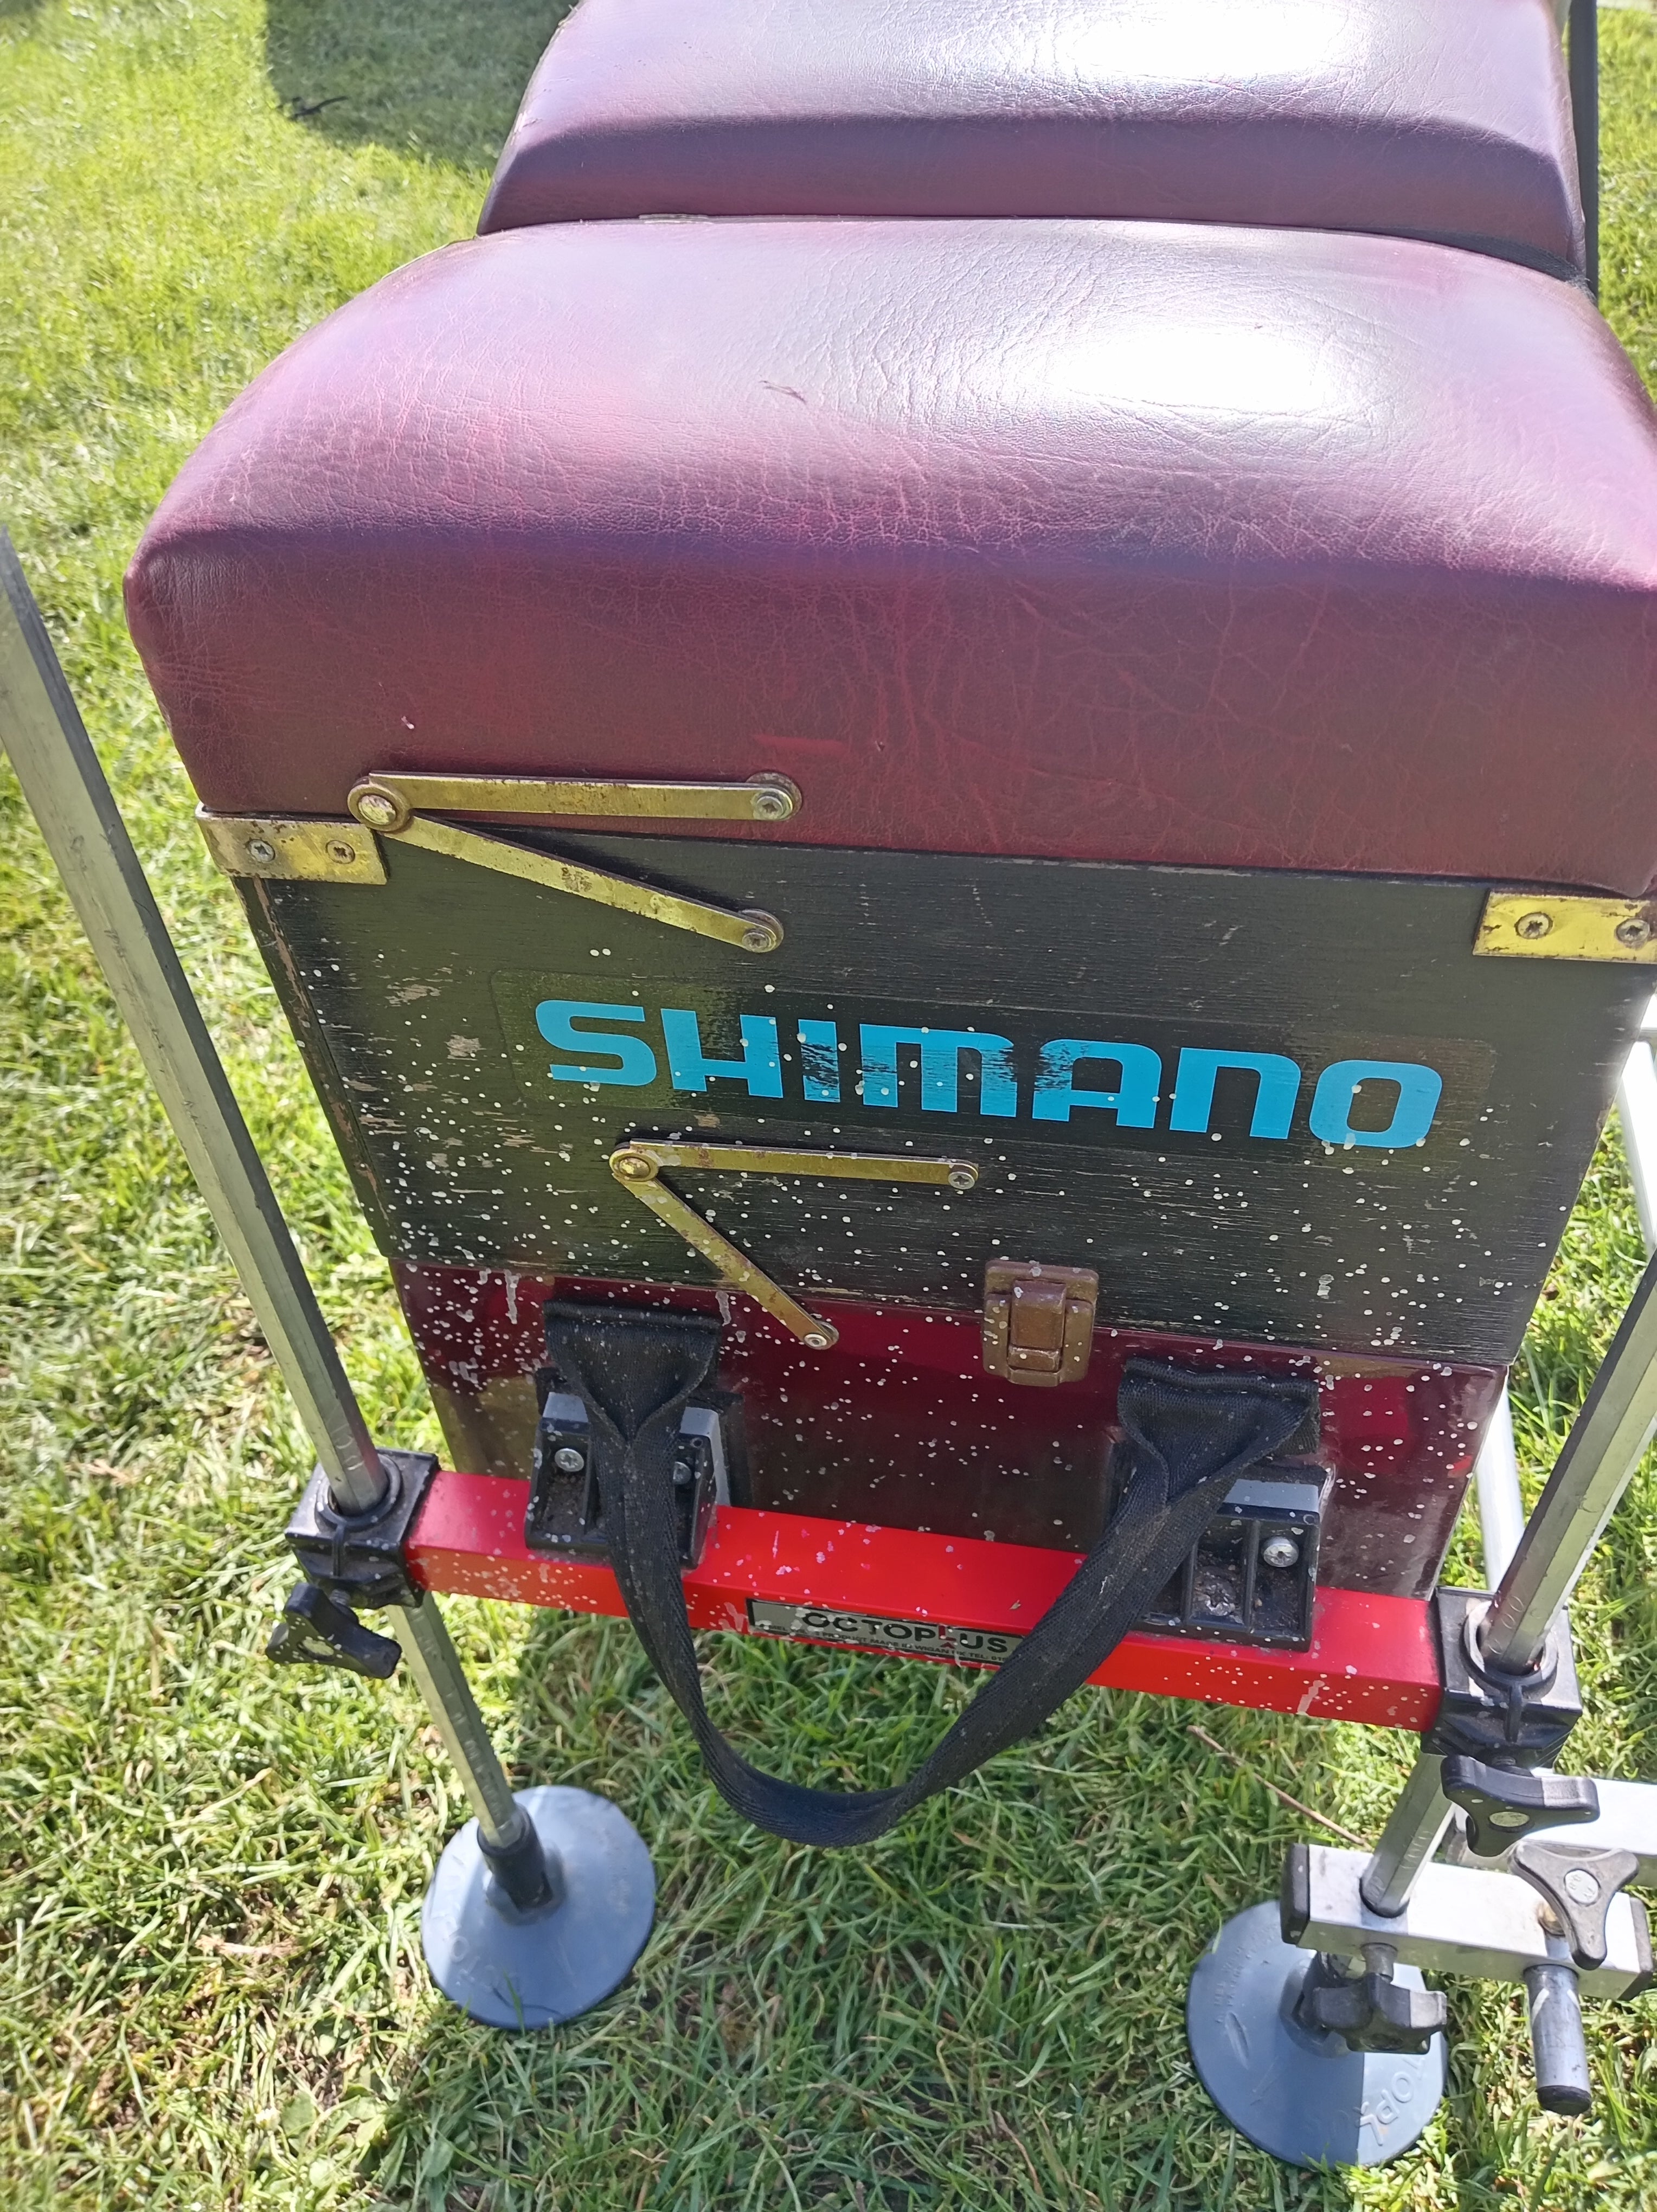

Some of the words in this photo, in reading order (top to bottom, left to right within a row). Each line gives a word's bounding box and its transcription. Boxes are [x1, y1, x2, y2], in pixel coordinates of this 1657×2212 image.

[536, 1001, 1443, 1148] SHIMANO
[801, 1612, 1008, 1653] OCTOPLUS
[870, 1638, 898, 1647] MADE
[914, 1644, 949, 1654] WIGAN
